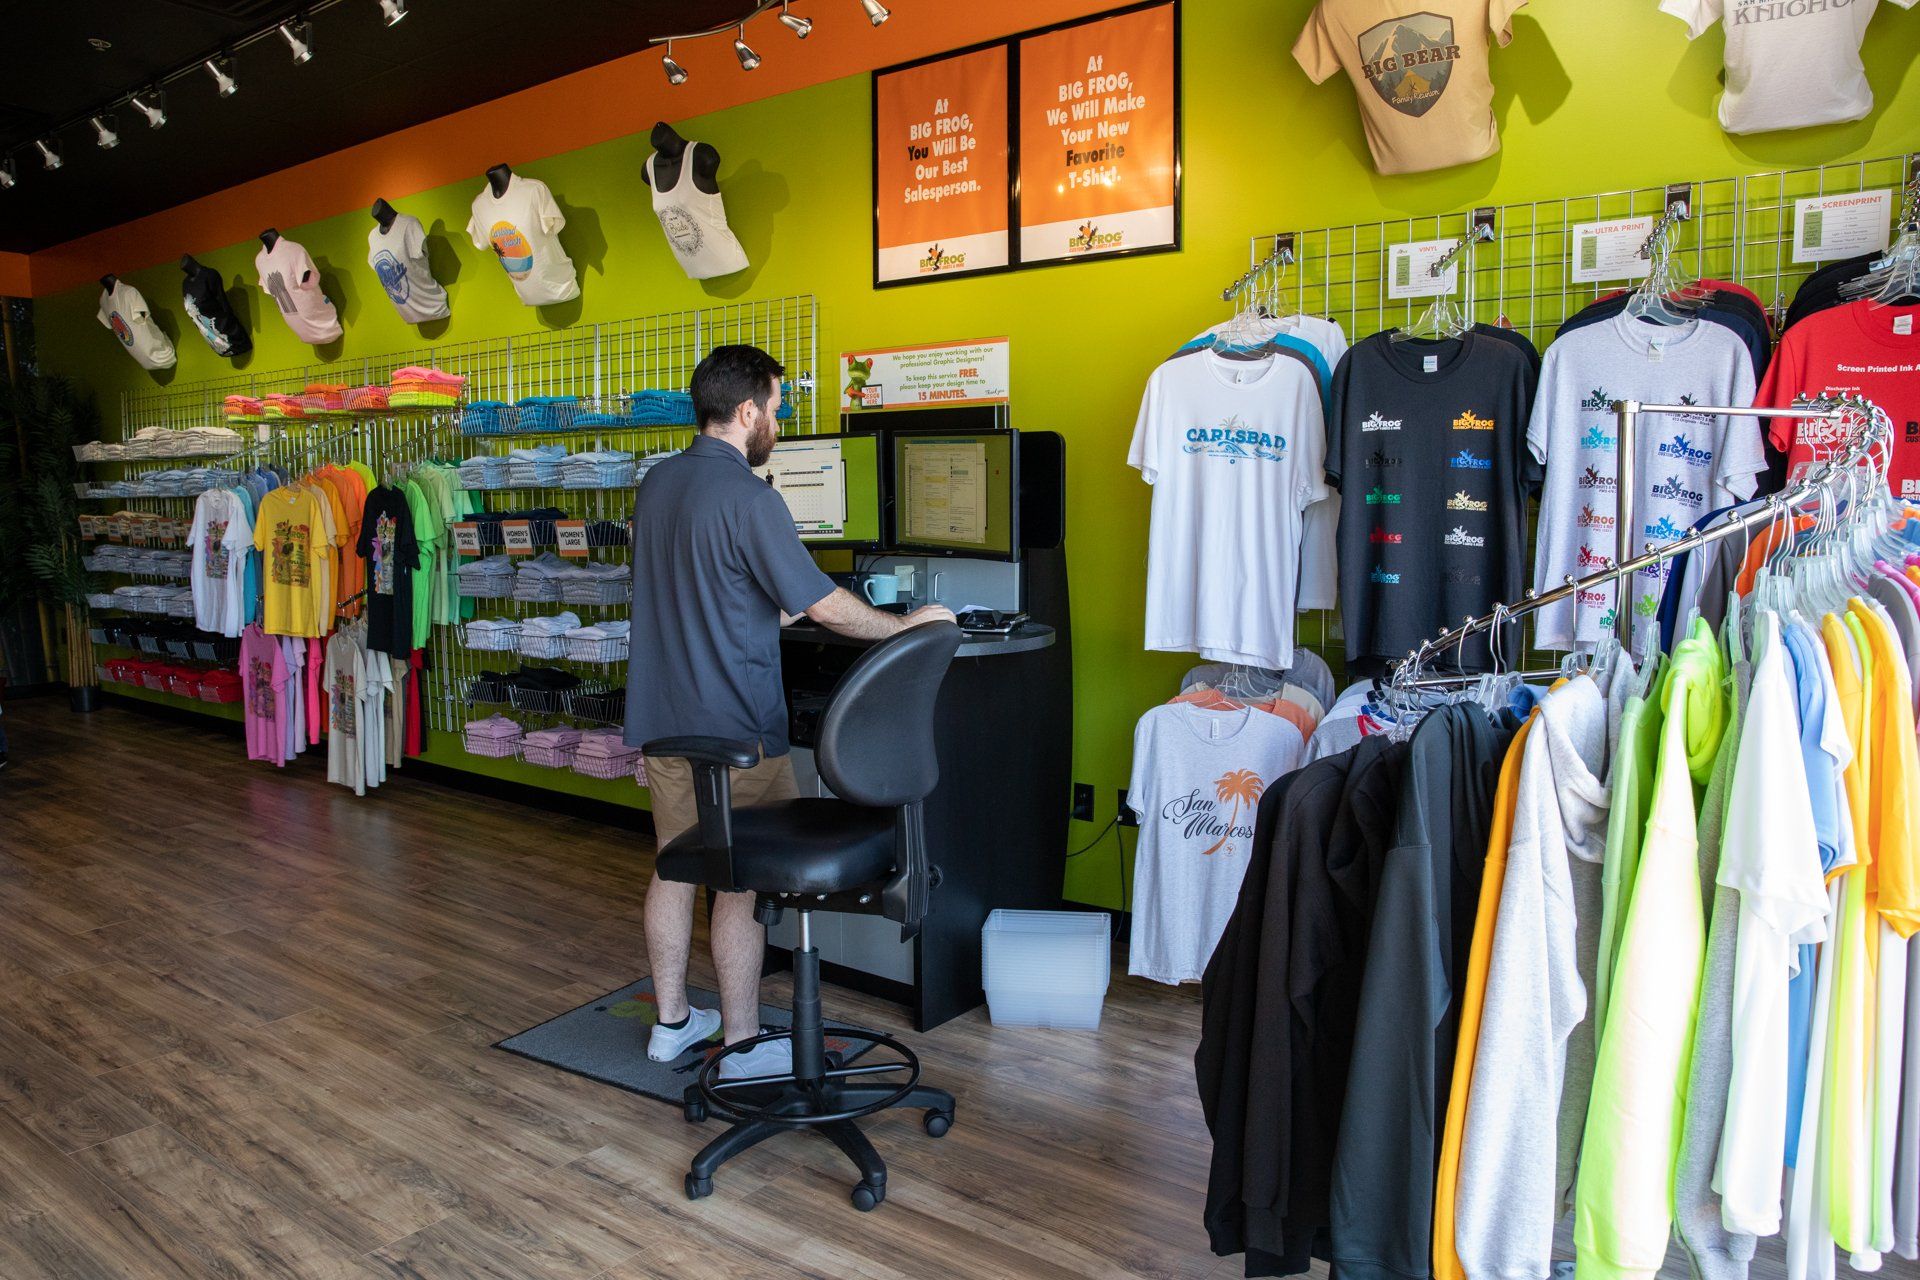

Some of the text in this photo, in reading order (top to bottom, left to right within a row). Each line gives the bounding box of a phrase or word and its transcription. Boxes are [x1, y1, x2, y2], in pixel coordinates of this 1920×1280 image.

[1087, 55, 1103, 73] At
[1362, 45, 1461, 79] BIG BEAR
[1058, 72, 1133, 102] BIG FROG,
[934, 99, 949, 116] At
[1392, 96, 1413, 105] Family
[1047, 92, 1146, 127] We Will Make
[910, 114, 974, 141] BIG FROG,
[1061, 121, 1130, 146] Your New
[908, 136, 976, 161] You Will Be
[1066, 142, 1125, 167] Favorite
[915, 157, 968, 181] Our Best
[1069, 166, 1122, 189] T-Shirt.
[904, 179, 981, 204] Salesperson.
[1822, 196, 1883, 209] SCREENPRINT
[1595, 226, 1619, 235] ULTRA
[1621, 223, 1645, 231] PRINT
[1091, 232, 1122, 245] FROG
[939, 253, 965, 265] FROG
[900, 355, 985, 369] professional Graphic Designers!
[902, 353, 915, 362] hope
[917, 352, 927, 360] you
[929, 351, 943, 360] enjoy
[945, 349, 968, 358] working
[1837, 364, 1865, 373] Screen
[1867, 365, 1898, 373] Printed
[1900, 364, 1913, 372] Ink
[913, 374, 926, 383] keep
[917, 383, 931, 391] keep
[933, 382, 945, 390] your
[947, 380, 965, 389] design
[918, 388, 968, 400] 15 MINUTES.
[1186, 428, 1287, 450] CARLSBAD
[1659, 443, 1713, 461] BIG FROG
[1652, 485, 1703, 501] BIG FROG
[1589, 515, 1615, 524] FROG
[456, 532, 477, 540] WOMEN'S
[506, 530, 529, 538] WOMEN'S
[560, 530, 584, 538] WOMEN'S
[1645, 525, 1666, 535] BIG
[509, 537, 528, 545] MEDIUM
[1163, 789, 1217, 820] San
[1173, 812, 1254, 840] Marcos
